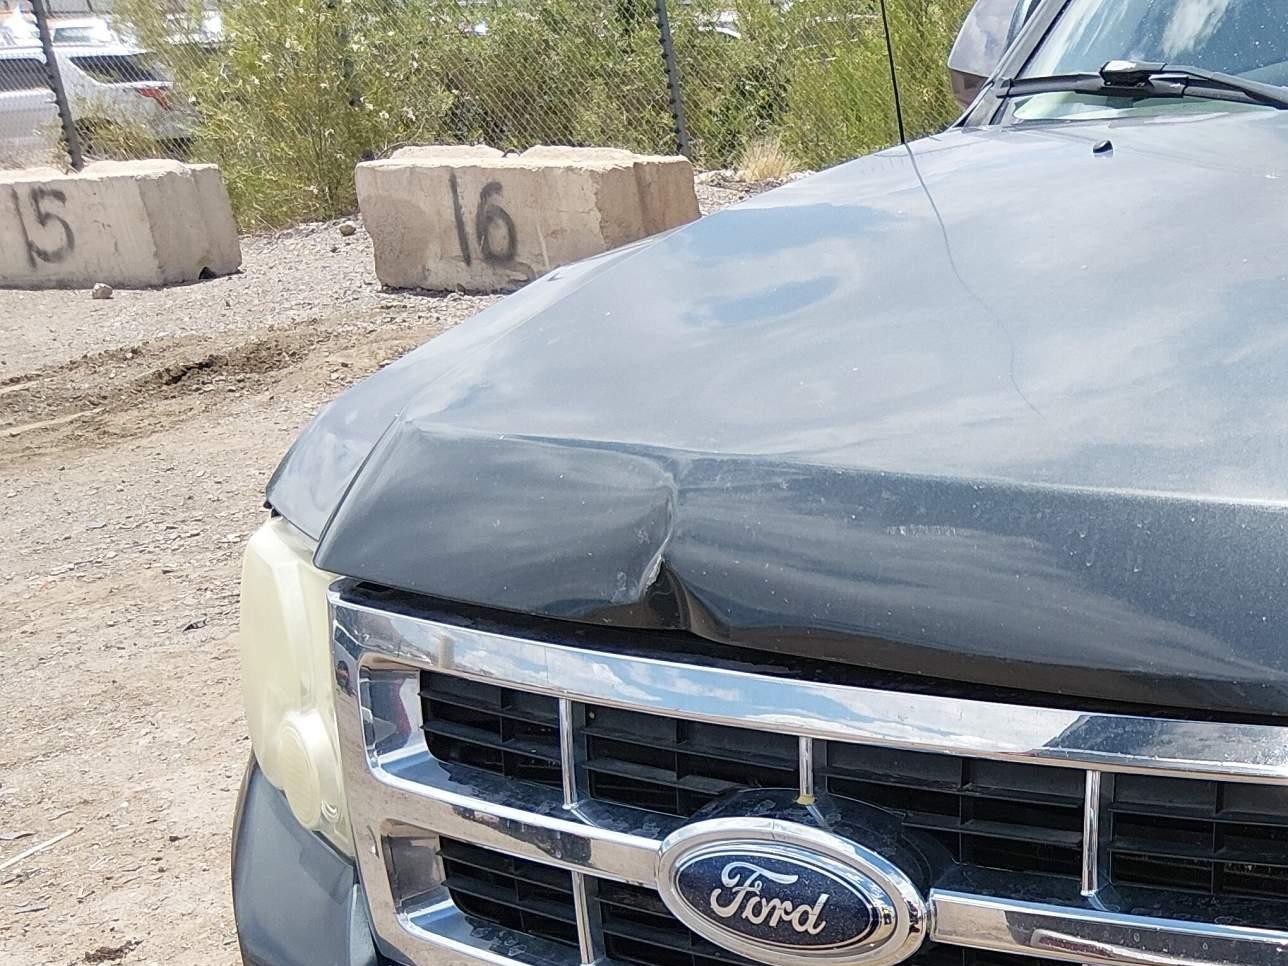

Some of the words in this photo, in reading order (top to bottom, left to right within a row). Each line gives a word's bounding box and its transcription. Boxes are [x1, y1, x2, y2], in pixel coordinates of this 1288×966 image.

[11, 185, 75, 269] 15
[449, 172, 517, 266] 16
[710, 861, 829, 935] Ford
